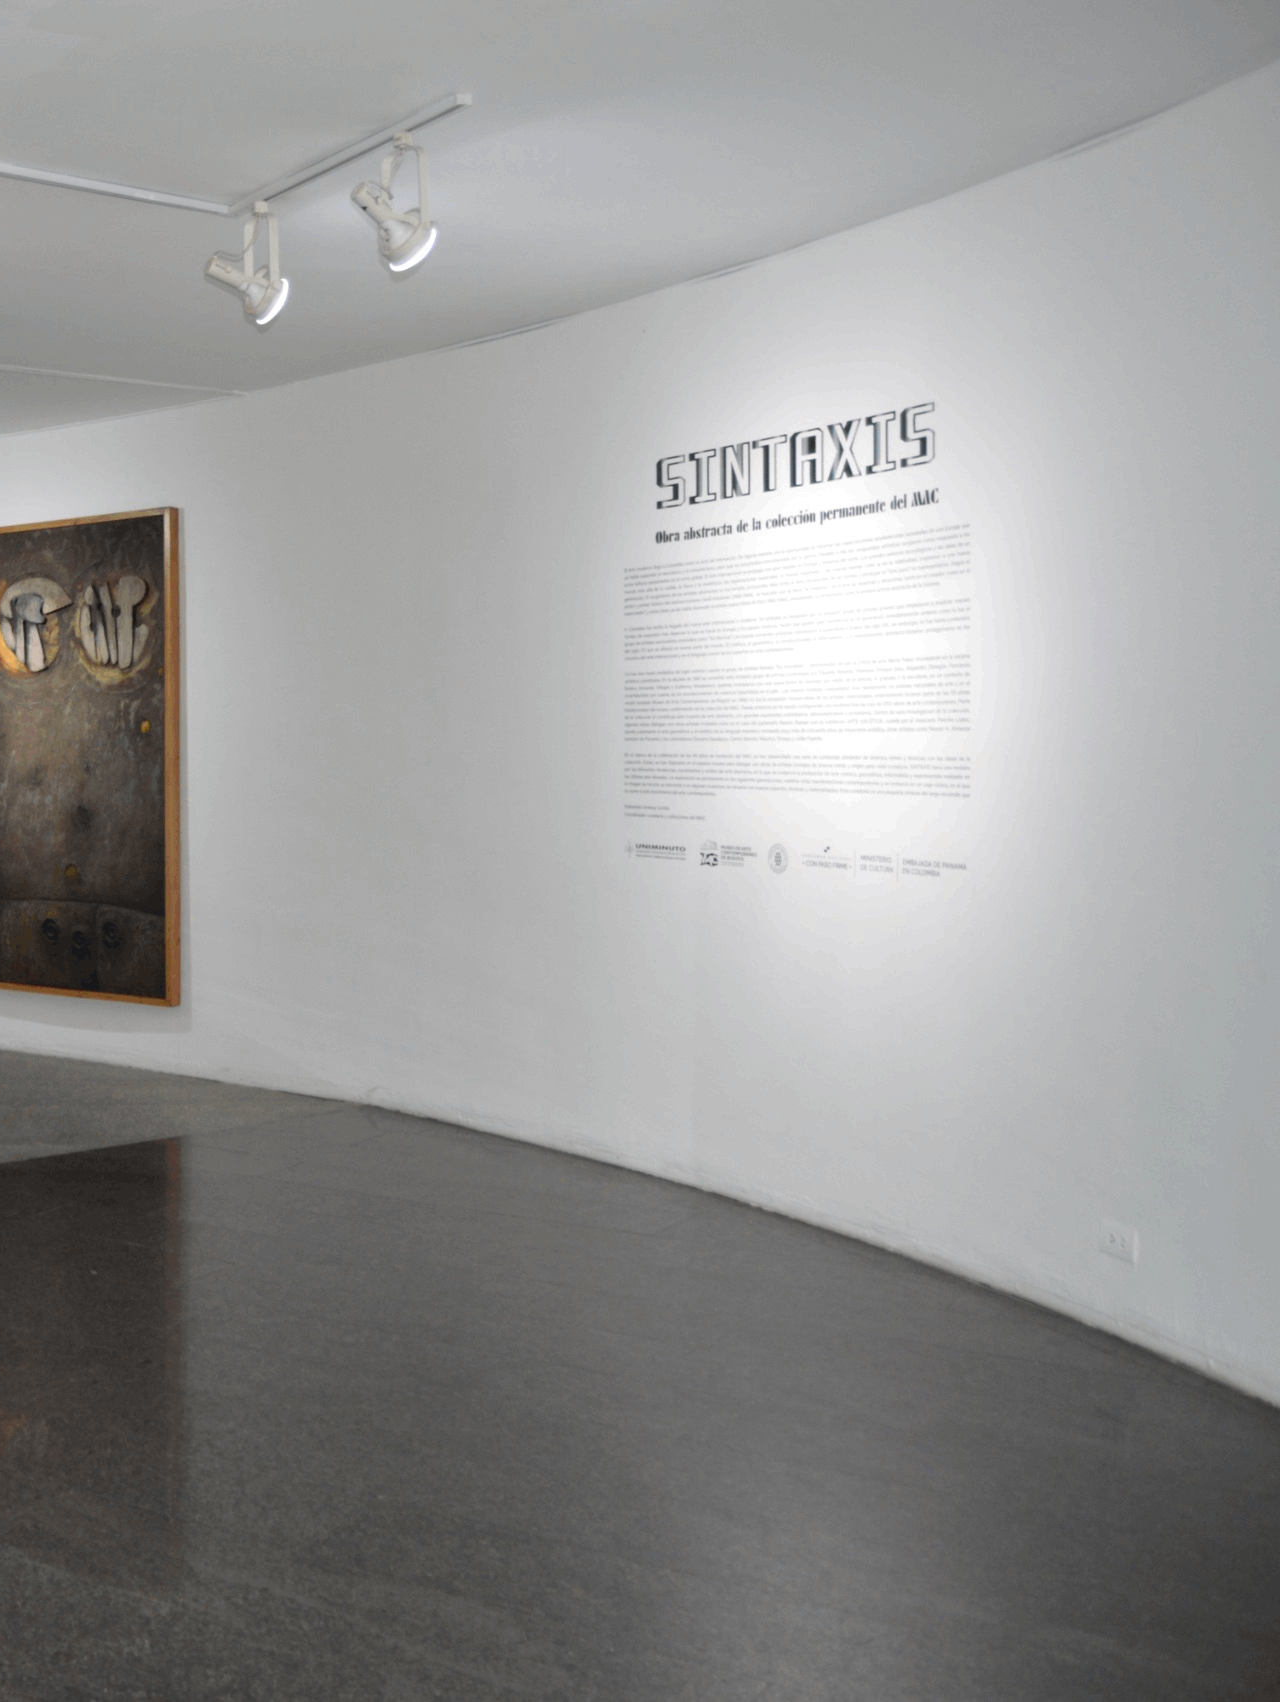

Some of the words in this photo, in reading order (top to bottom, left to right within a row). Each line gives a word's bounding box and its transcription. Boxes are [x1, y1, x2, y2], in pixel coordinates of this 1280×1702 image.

[655, 401, 936, 510] SINTAXIS
[655, 527, 680, 544] Obra
[683, 521, 732, 542] abstracta
[736, 519, 749, 534] de
[752, 516, 762, 532] la
[820, 498, 886, 526] permanente
[890, 492, 907, 511] del
[911, 487, 939, 507] MAC
[635, 843, 686, 852] UNIMINUTO
